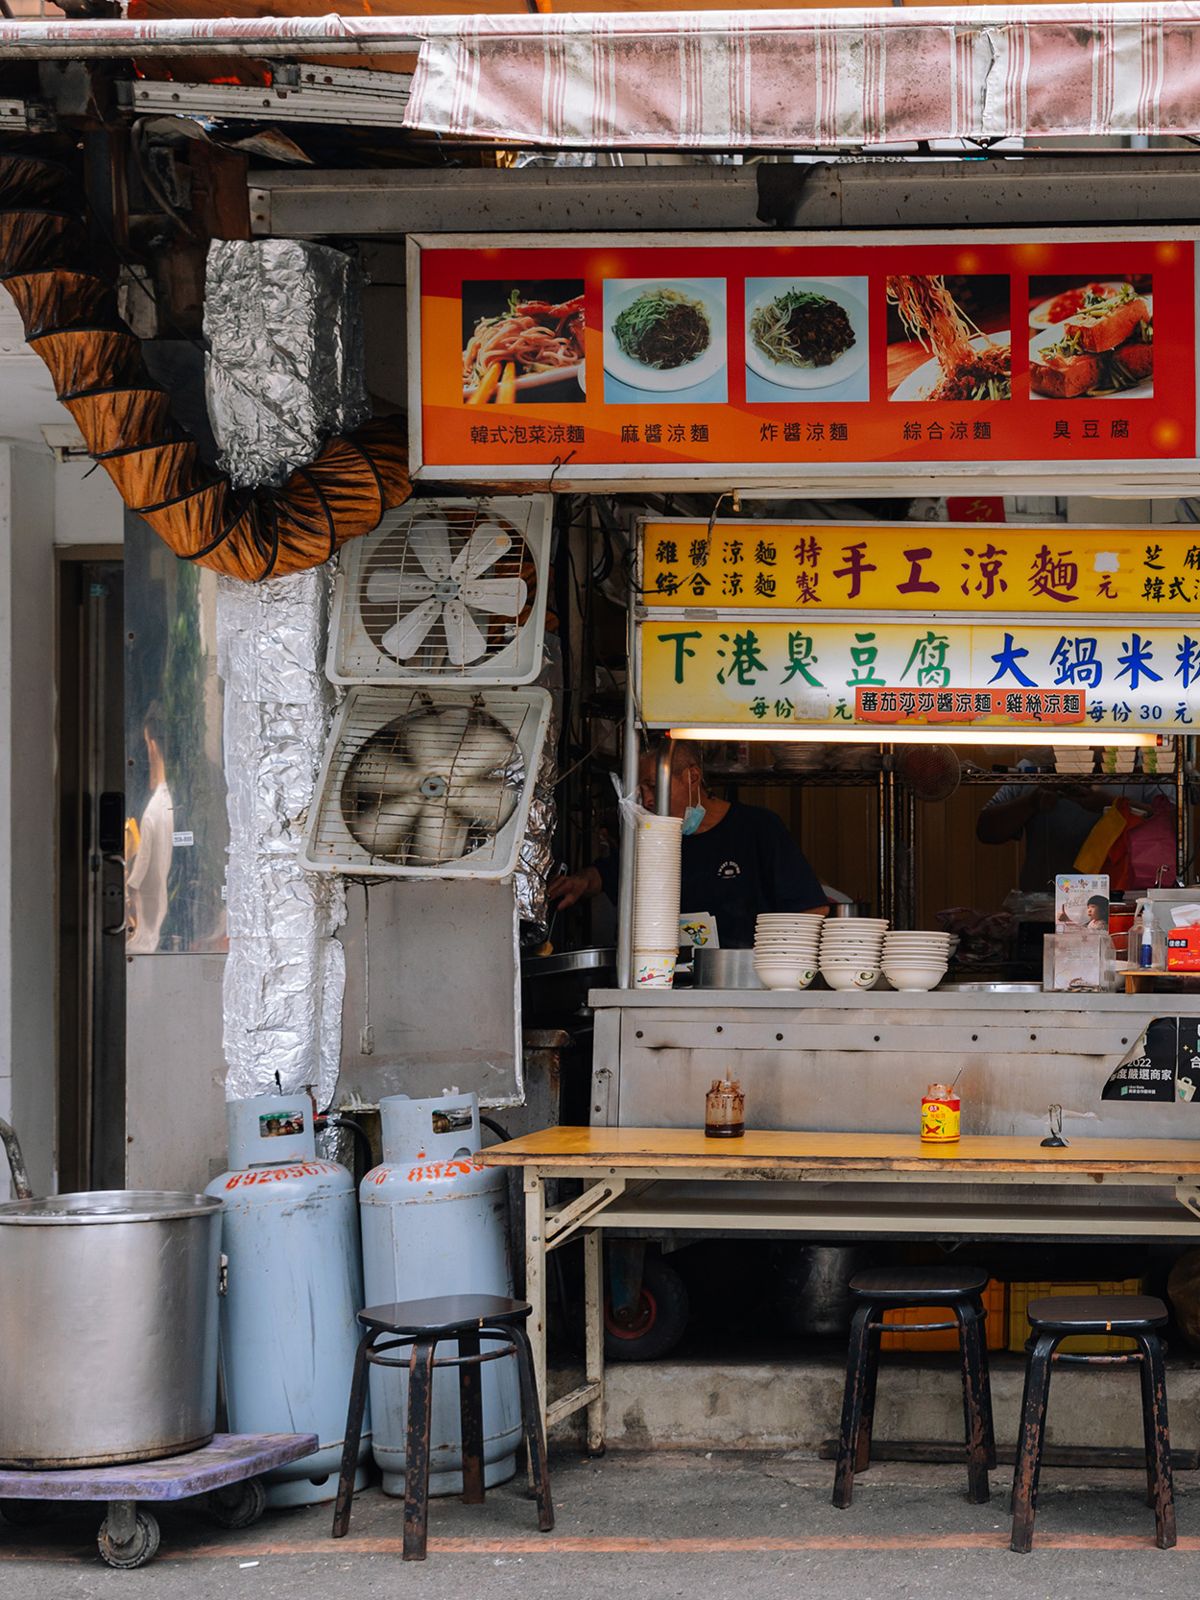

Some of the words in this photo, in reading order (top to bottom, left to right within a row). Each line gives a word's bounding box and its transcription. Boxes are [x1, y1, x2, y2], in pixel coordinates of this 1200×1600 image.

[469, 424, 586, 444] 韓式泡菜涼麵
[620, 423, 711, 444] 麻醬涼麵
[759, 422, 850, 443] 炸醬涼麵
[902, 420, 993, 441] 綜合涼麵
[1052, 418, 1131, 440] 臭豆腐
[654, 538, 778, 567] 雜醬涼麵
[794, 534, 823, 605] 特製
[832, 540, 1080, 604] 手工涼麵
[654, 572, 778, 598] 綜合涼麵
[1096, 573, 1119, 600] 元
[657, 629, 951, 688] 下港臭豆腐
[748, 695, 795, 720] 每份
[832, 696, 853, 720] 元
[1126, 1058, 1152, 1068] 2022
